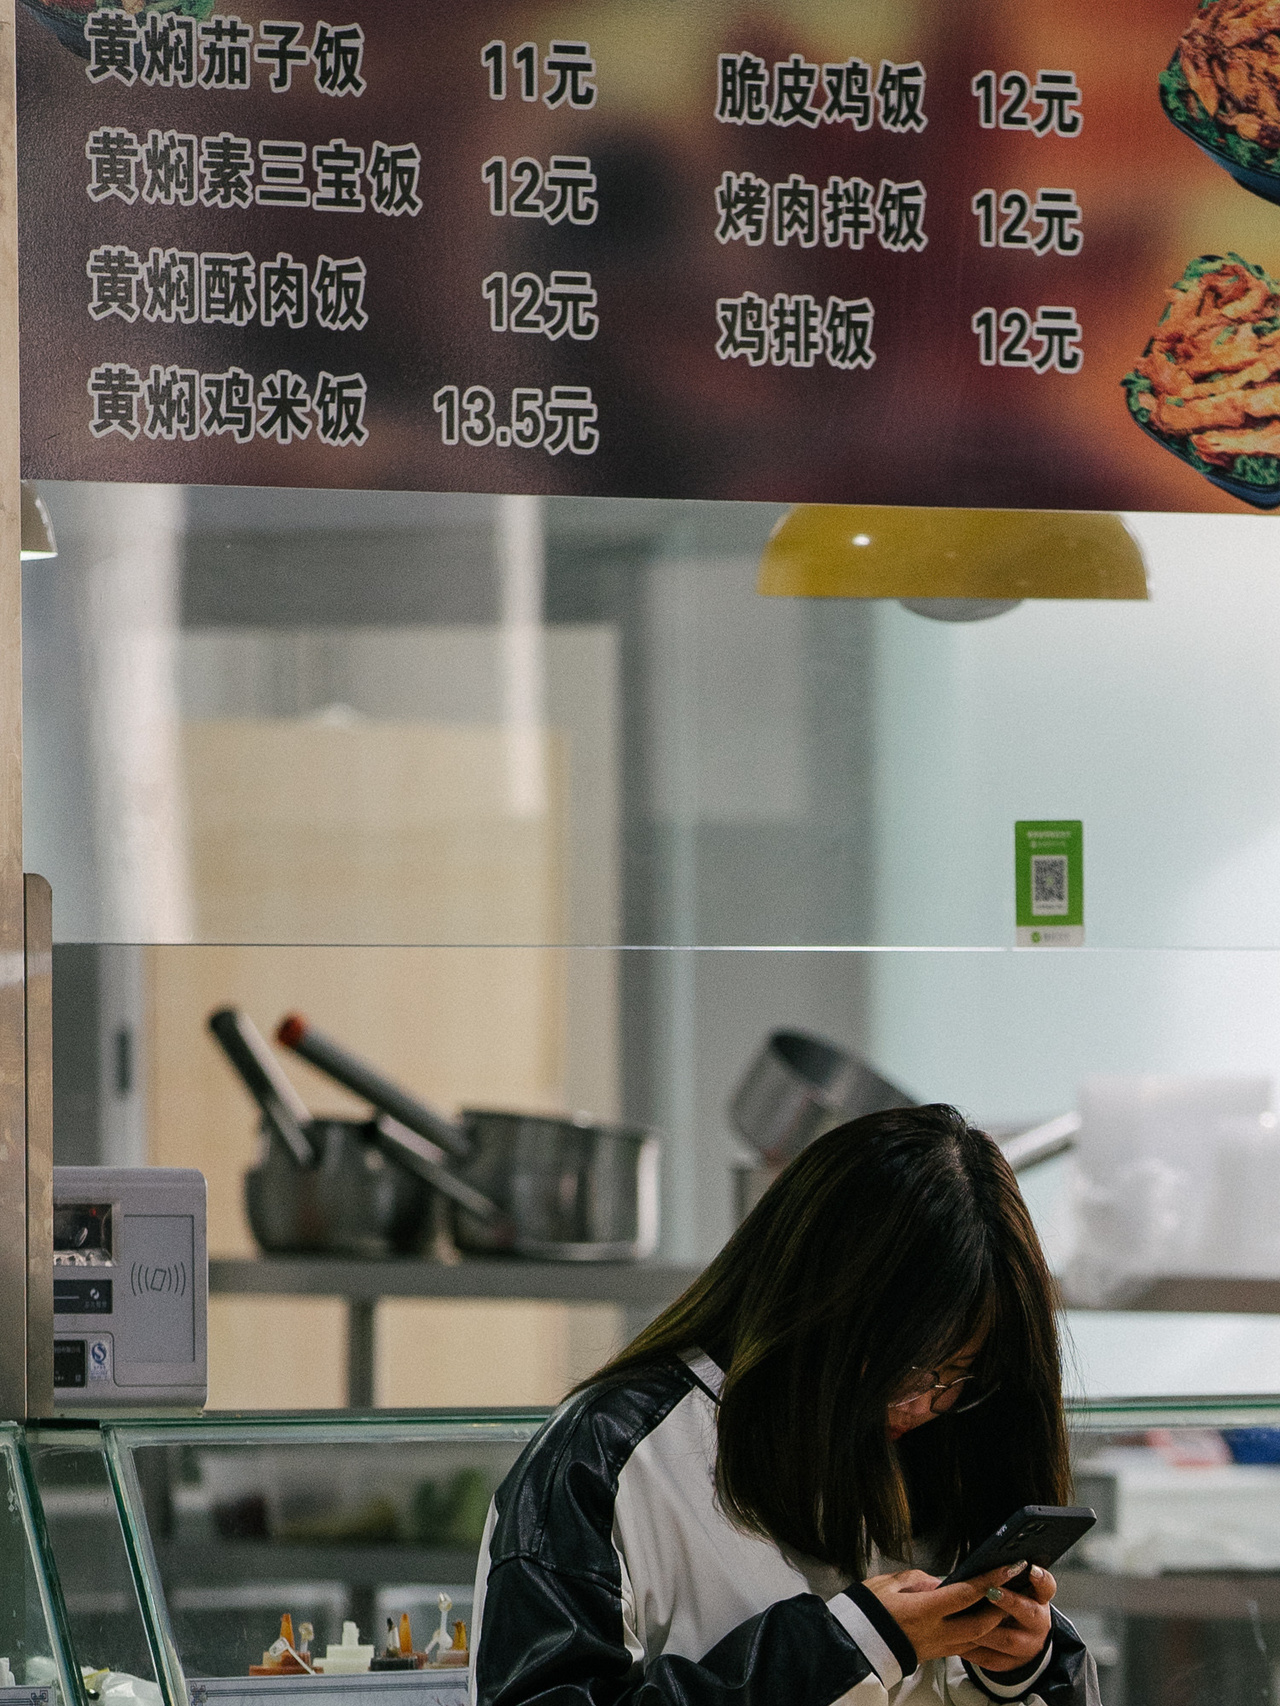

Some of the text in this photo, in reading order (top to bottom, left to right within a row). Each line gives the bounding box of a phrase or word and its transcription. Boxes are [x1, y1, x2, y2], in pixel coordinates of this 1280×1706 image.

[85, 8, 598, 109] 黄焖茄子饭 11元
[715, 52, 1083, 137] 脆皮鸡饭 12元
[86, 127, 599, 225] 黄焖素三宝饭 12元
[715, 171, 1083, 256] 烤肉拌饭 12元
[87, 245, 599, 340] 黄焖酥肉饭 12元
[715, 291, 1083, 374] 鸡排饭 12元
[88, 363, 599, 456] 黄焖鸡米饭 13.5元
